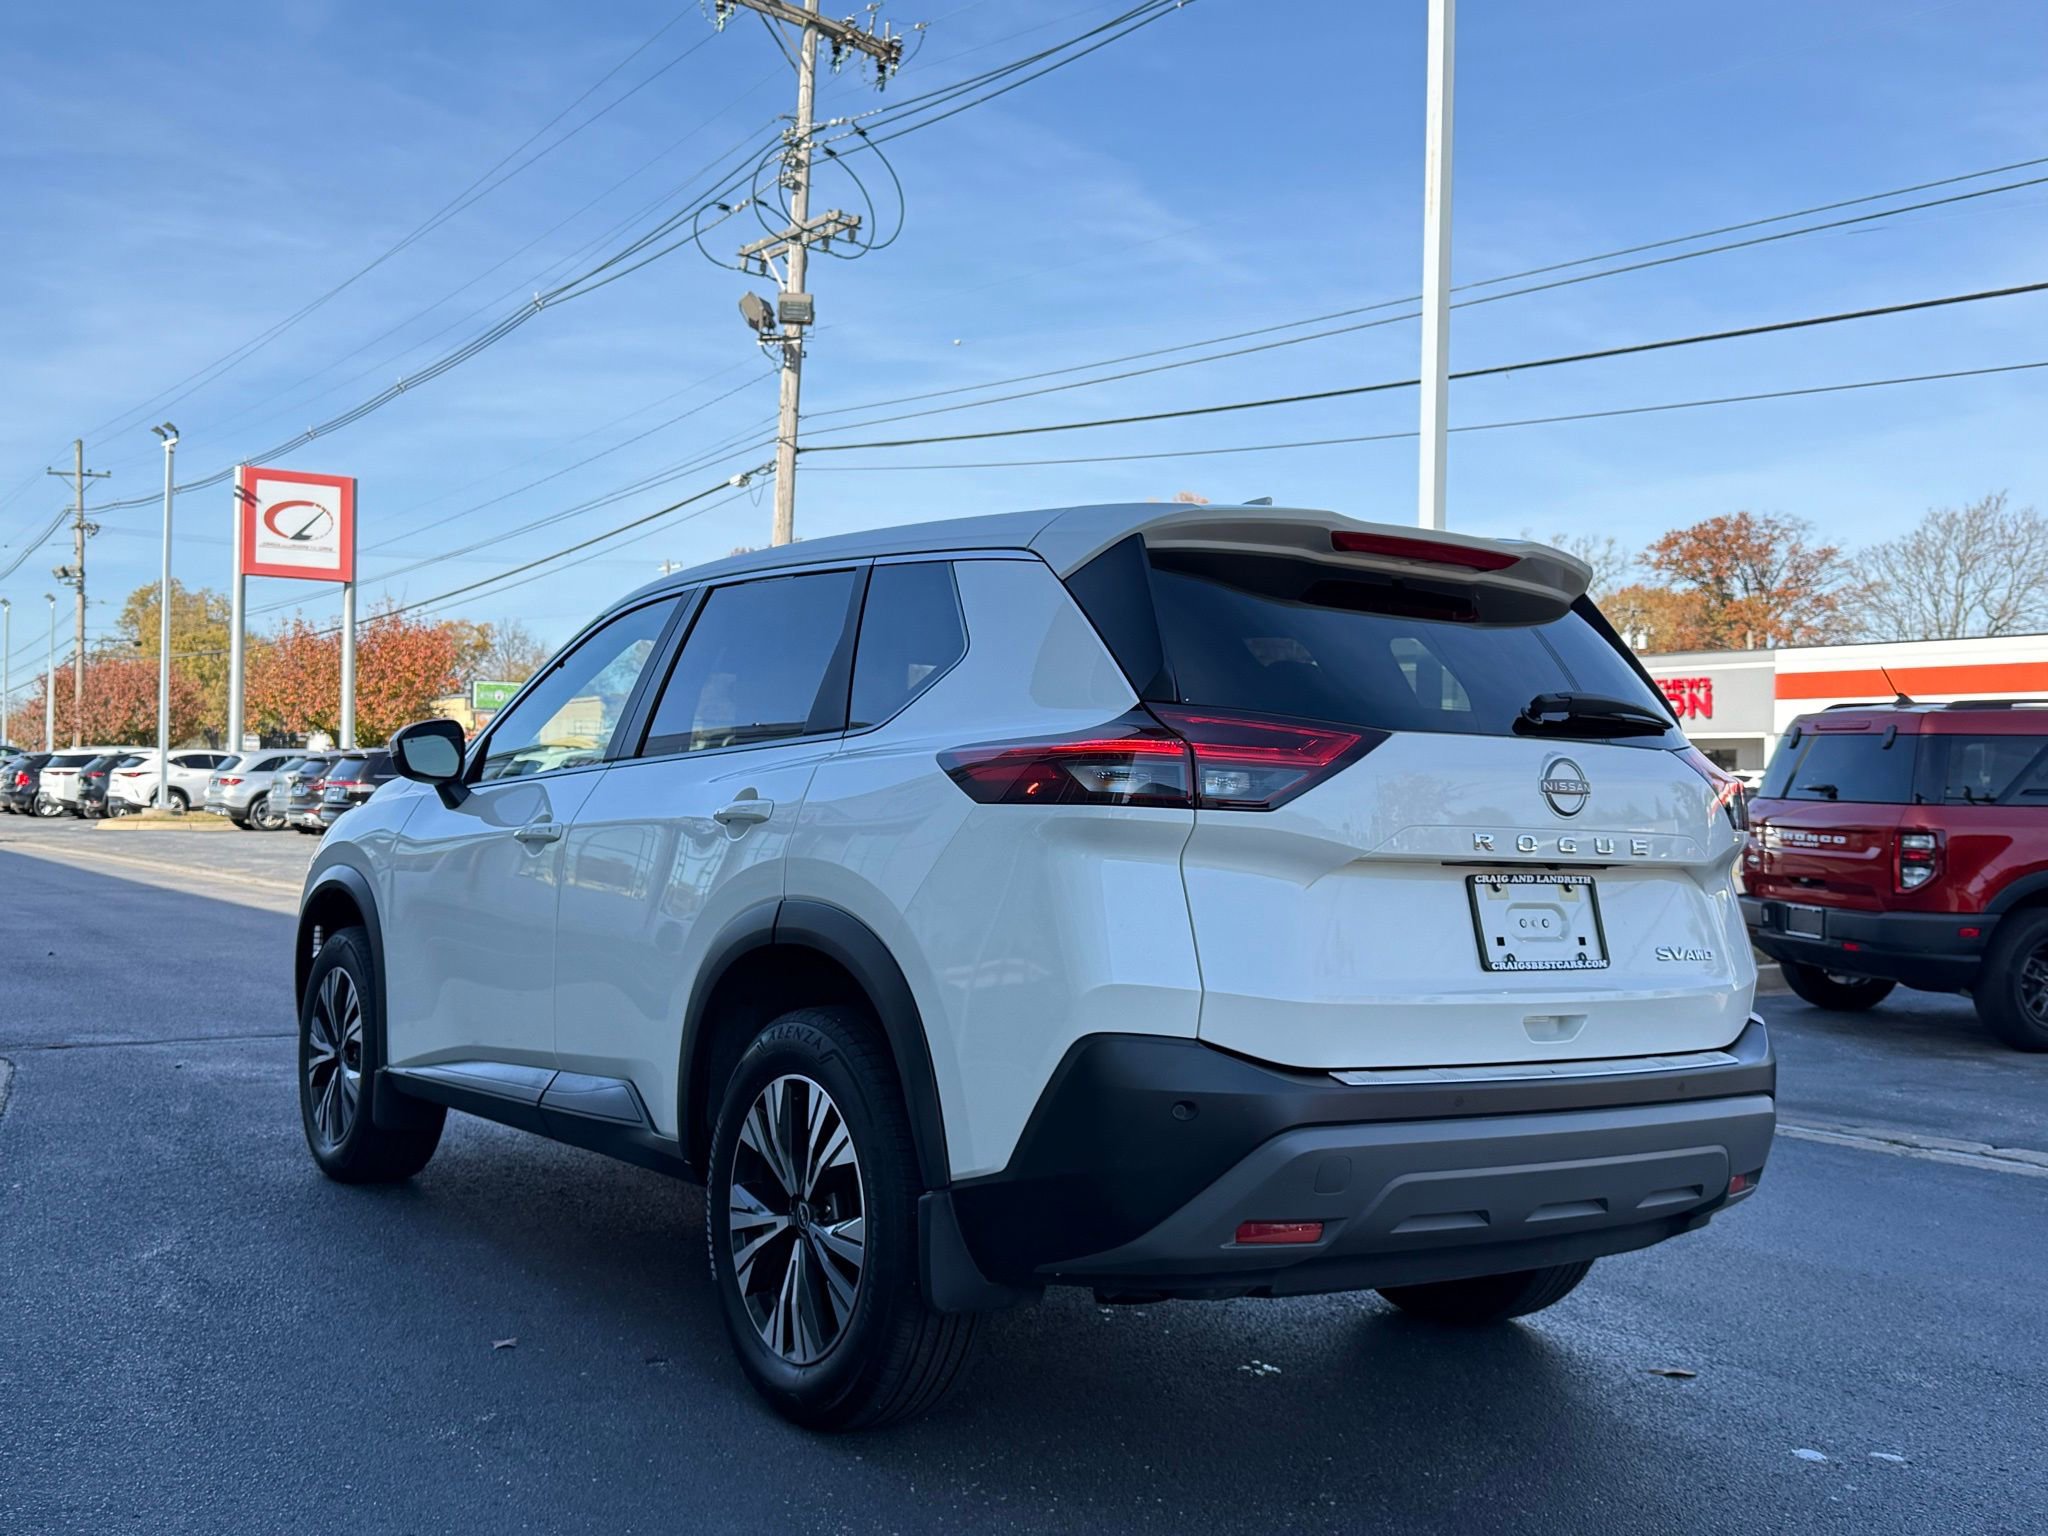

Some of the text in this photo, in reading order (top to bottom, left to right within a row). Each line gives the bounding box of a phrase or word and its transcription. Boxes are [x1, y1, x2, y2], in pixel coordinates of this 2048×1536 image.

[1543, 781, 1590, 793] NISSAN
[1473, 832, 1650, 855] ROGUE
[1773, 830, 1846, 844] RONCO
[1475, 874, 1591, 884] CRAIG AND LANDRETH
[1655, 946, 1682, 961] SV
[1491, 960, 1608, 970] CRAIGSBESTCARS.COM
[769, 1025, 823, 1050] ALENZA
